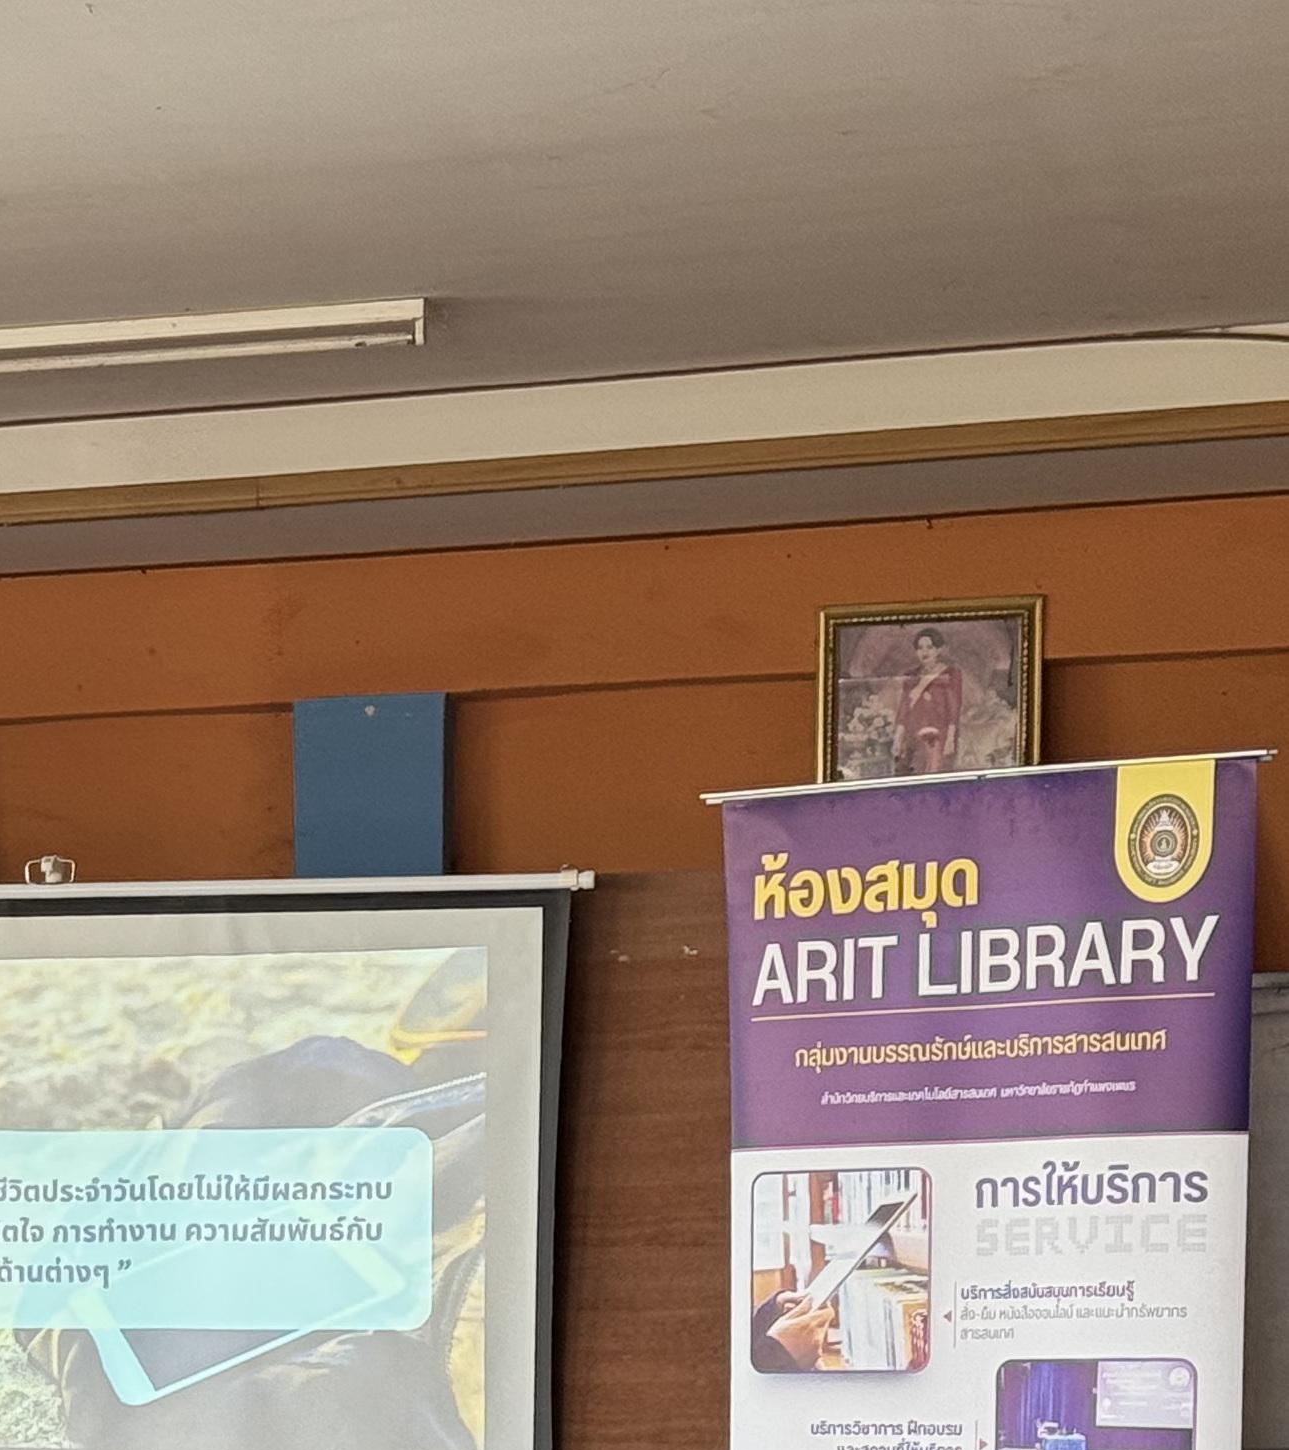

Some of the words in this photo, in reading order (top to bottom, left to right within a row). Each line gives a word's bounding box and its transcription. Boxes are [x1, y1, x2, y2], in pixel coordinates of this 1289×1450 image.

[752, 853, 978, 929] ห้องสมุด
[752, 935, 898, 1007] ARIT
[917, 915, 1219, 998] LIBRARY
[794, 1028, 1167, 1074] กลุ่มงานบรรณรักษ์และบริการสารสนเทศ
[975, 1160, 1209, 1209] การให้บริการ
[52, 1217, 177, 1243] การทำงาน
[185, 1215, 384, 1242] ความสัมพันธ์กับ
[975, 1213, 1208, 1257] SERVICE
